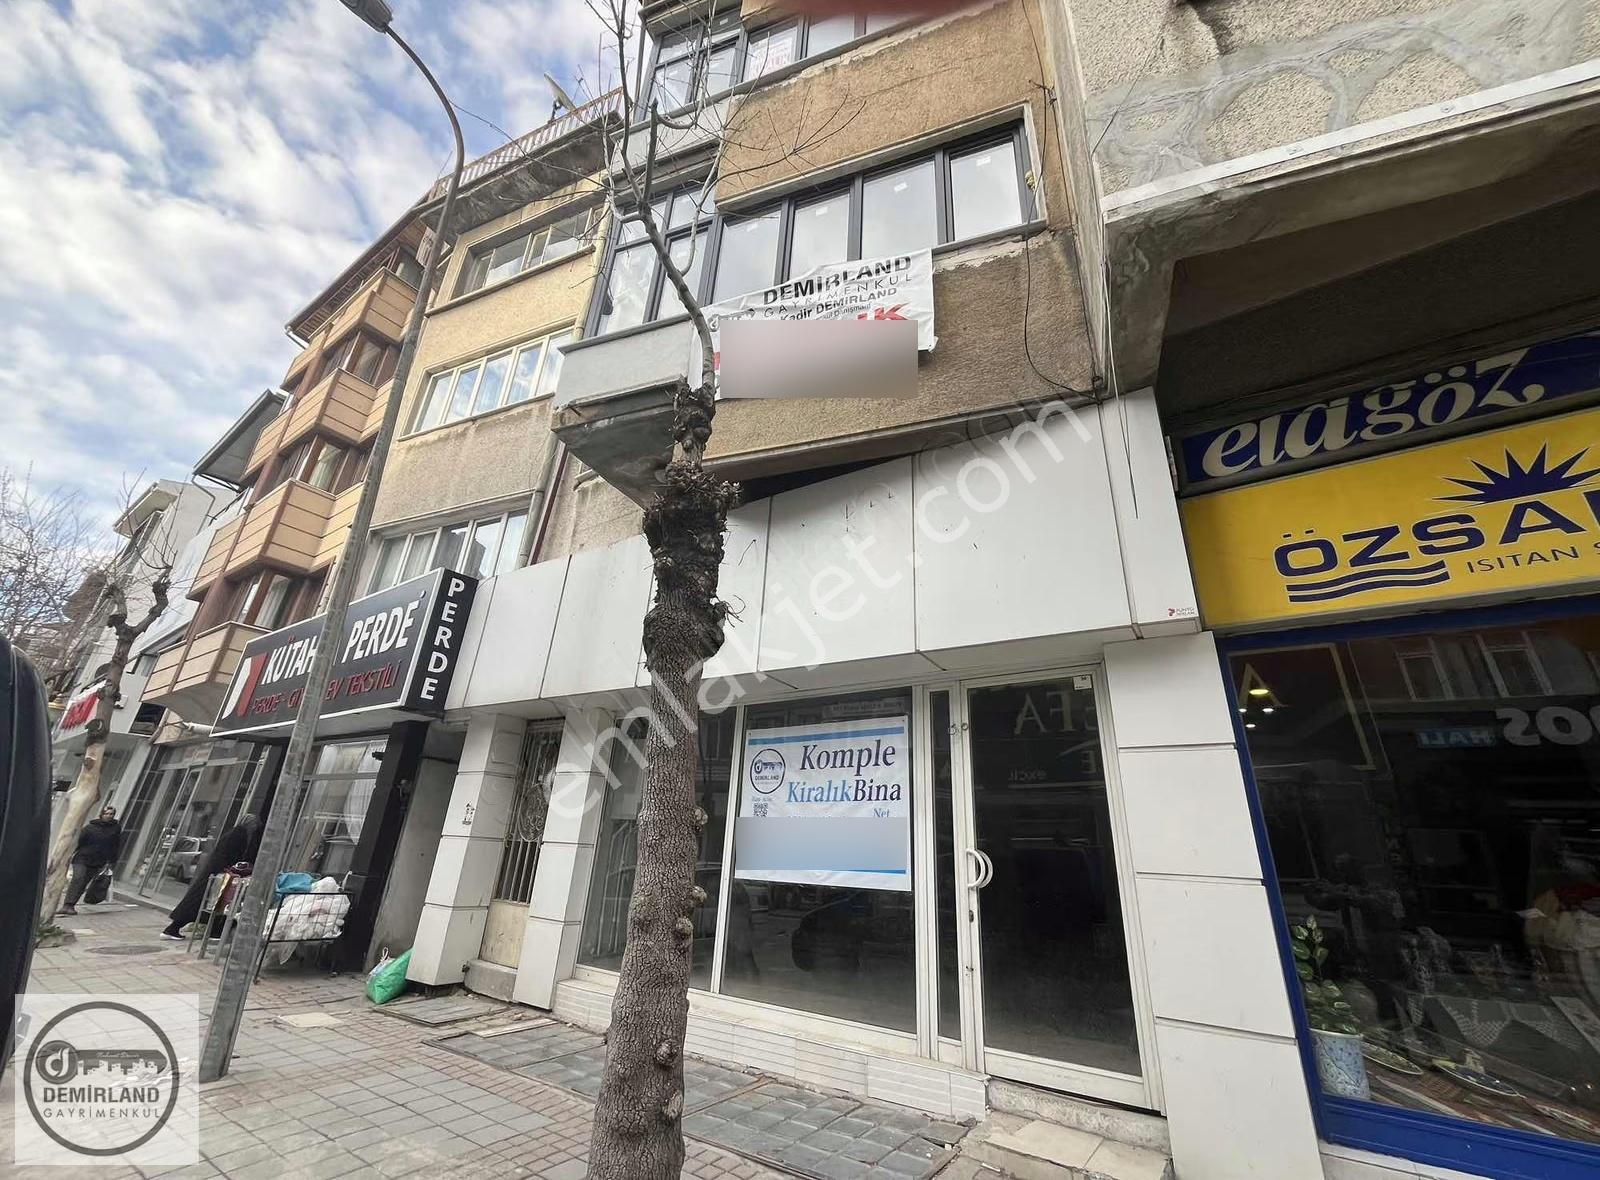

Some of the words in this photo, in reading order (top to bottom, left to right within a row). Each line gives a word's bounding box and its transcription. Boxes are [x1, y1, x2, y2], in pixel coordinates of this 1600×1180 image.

[1466, 546, 1579, 575] ISITAN
[340, 600, 420, 665] PERDE
[420, 576, 466, 701] PERDE
[799, 739, 896, 777] Komple
